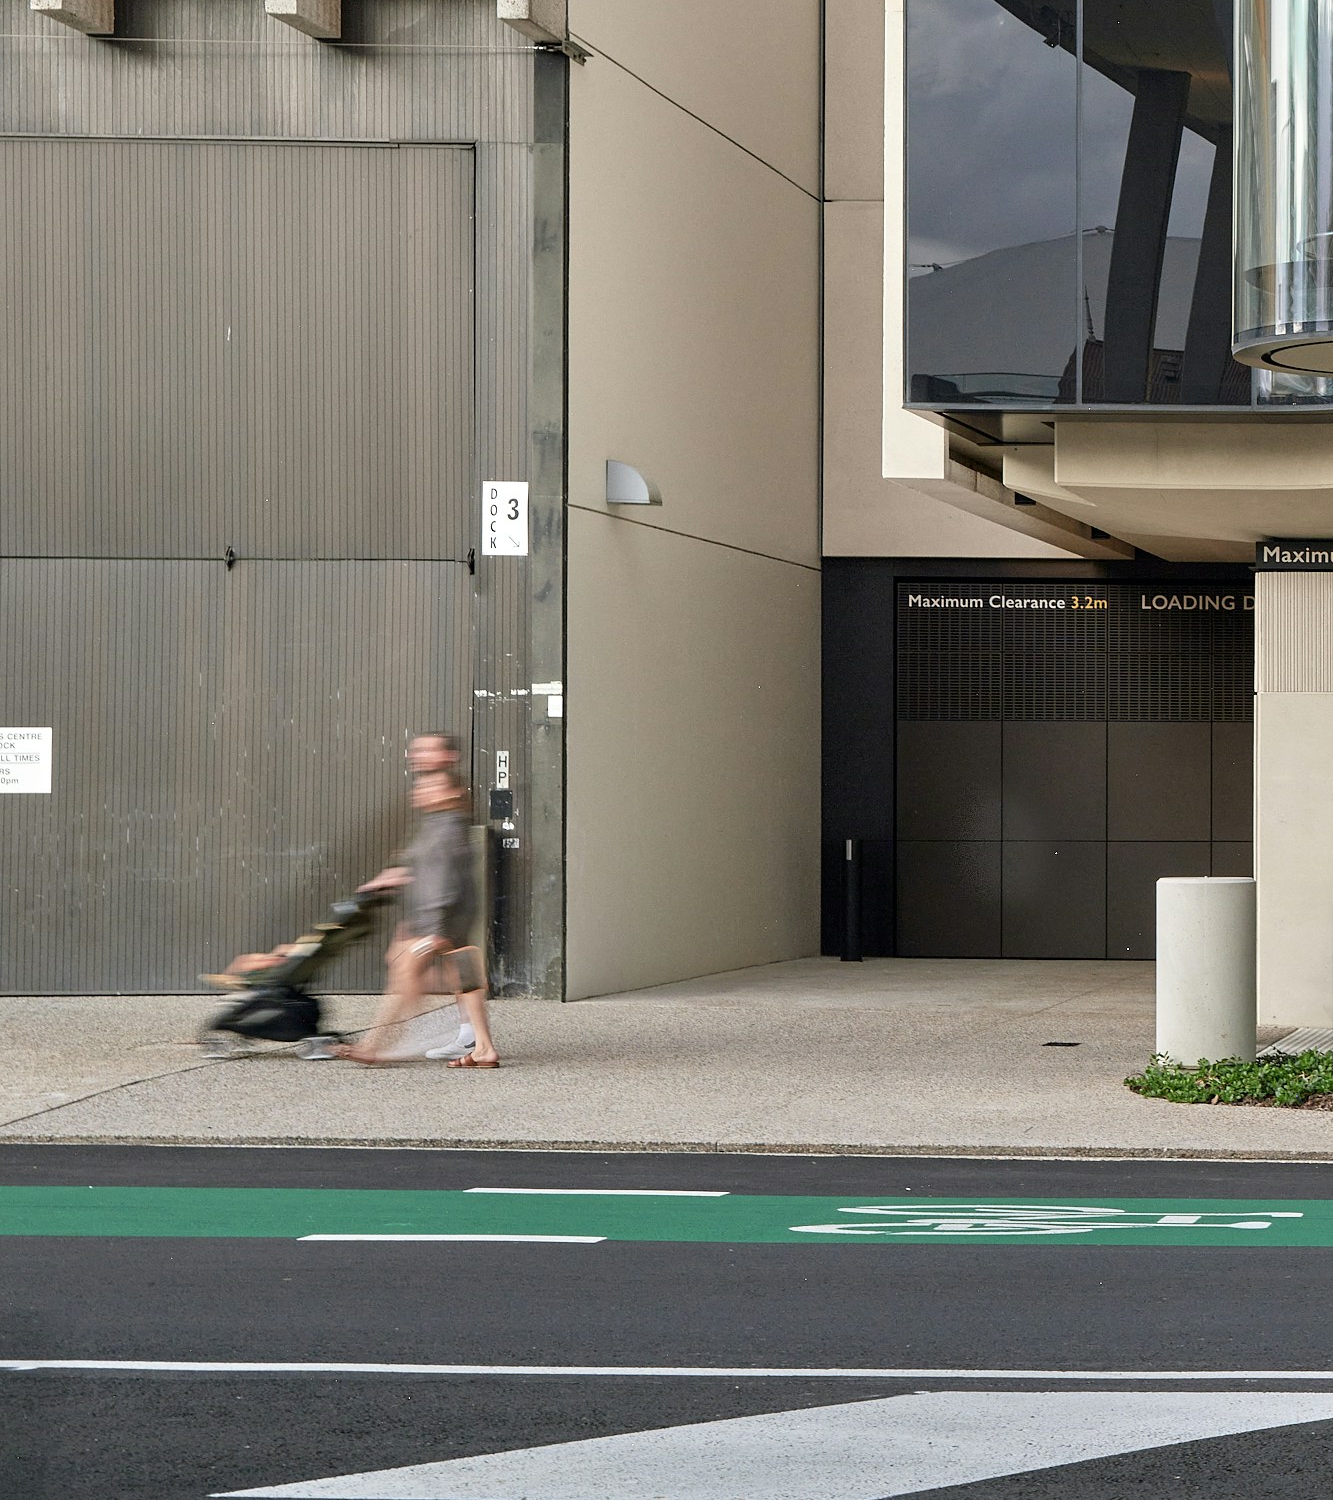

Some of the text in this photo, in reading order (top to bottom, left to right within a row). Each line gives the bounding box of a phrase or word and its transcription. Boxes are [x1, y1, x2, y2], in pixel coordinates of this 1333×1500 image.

[490, 488, 498, 549] DOCK
[507, 498, 519, 520] 3
[908, 594, 1108, 610] Maximum Clearance 3.2m
[1141, 595, 1236, 610] LOADING
[7, 732, 43, 740] CENTRE
[498, 756, 508, 784] HP
